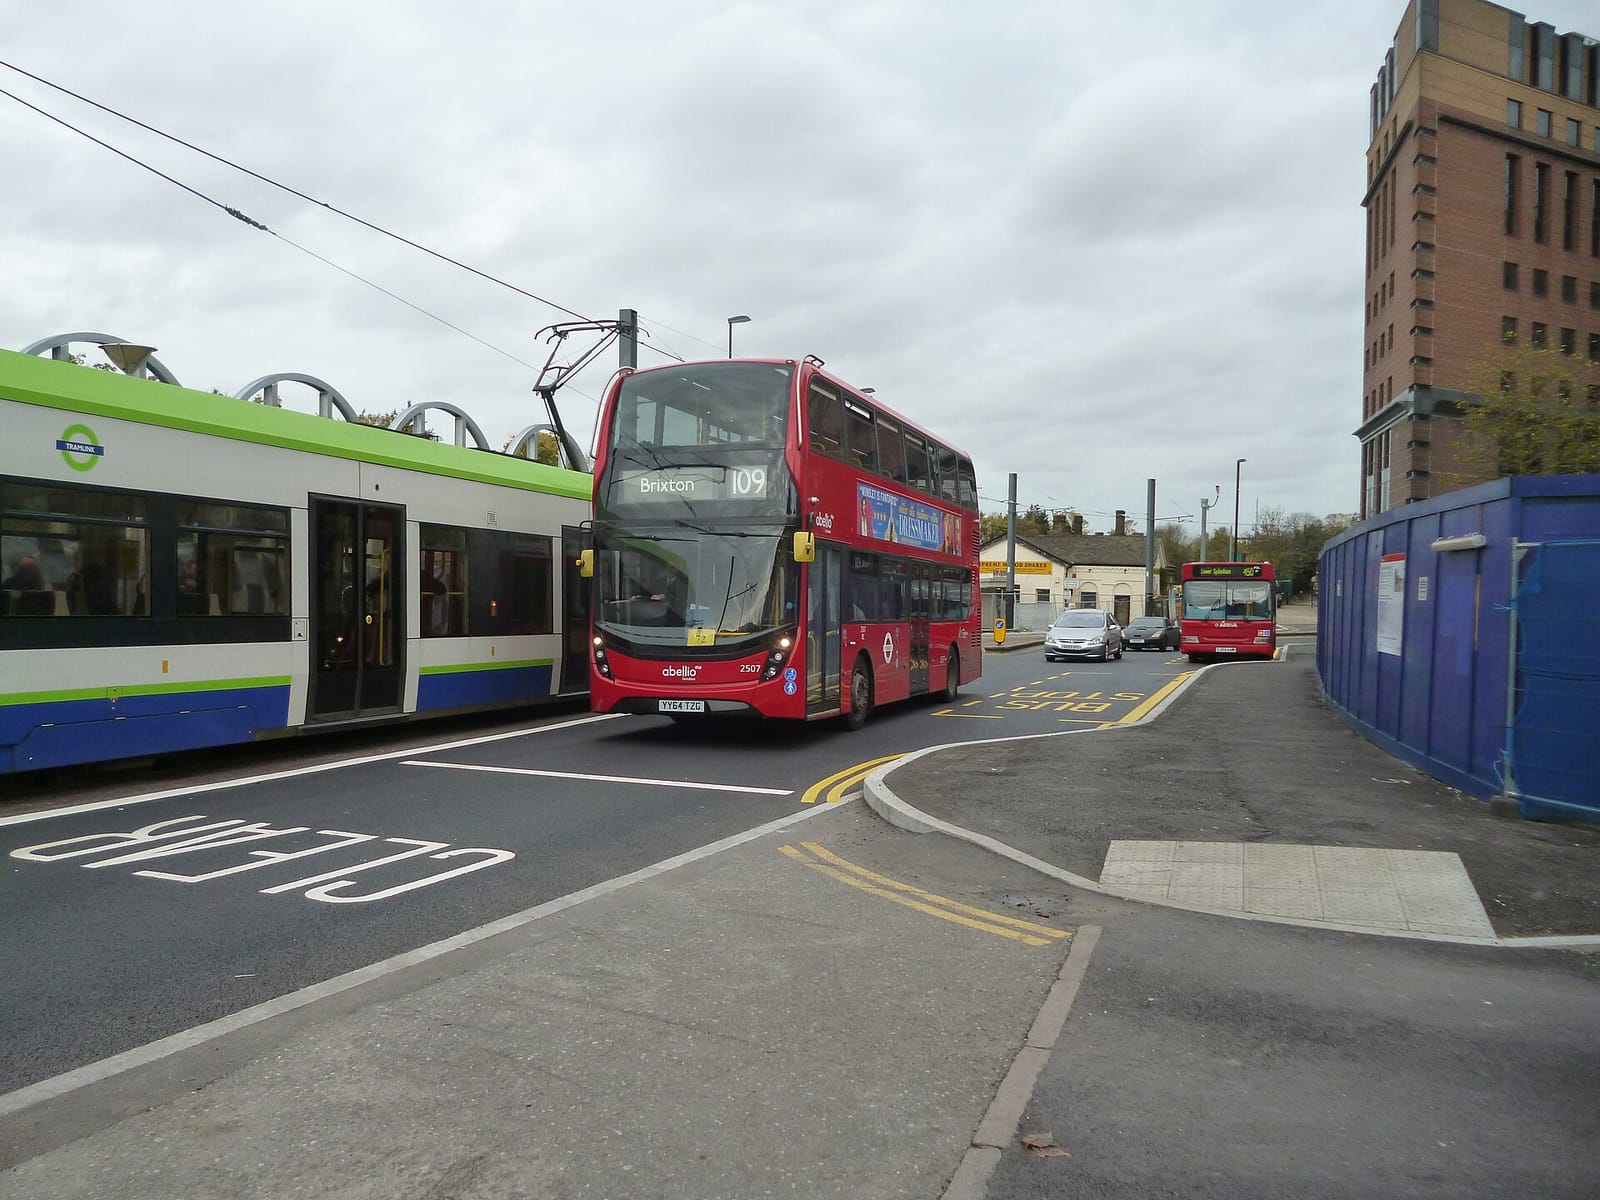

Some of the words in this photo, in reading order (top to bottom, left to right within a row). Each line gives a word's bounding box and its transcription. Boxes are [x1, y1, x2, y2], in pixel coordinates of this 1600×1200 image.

[65, 442, 96, 453] TRAMLINK
[640, 478, 695, 493] Brixton
[732, 468, 765, 494] 109
[899, 514, 939, 543] DRESSMAKER
[662, 666, 697, 677] abellio
[740, 665, 760, 673] 2507
[1010, 691, 1145, 701] STOP
[662, 702, 682, 710] YY64
[685, 702, 701, 711] TZG
[995, 700, 1112, 712] BUS
[9, 815, 516, 904] CLEAR
